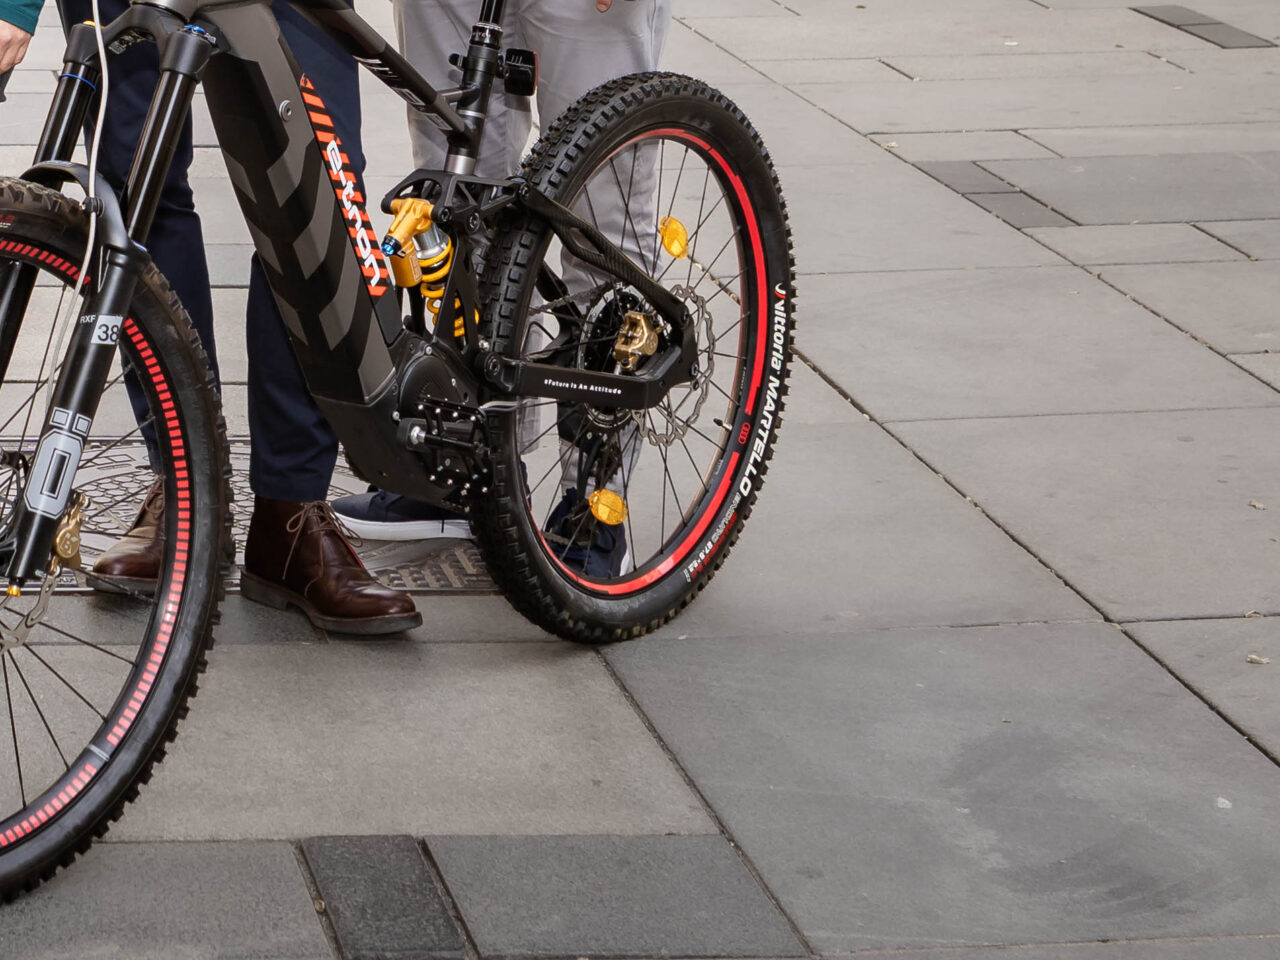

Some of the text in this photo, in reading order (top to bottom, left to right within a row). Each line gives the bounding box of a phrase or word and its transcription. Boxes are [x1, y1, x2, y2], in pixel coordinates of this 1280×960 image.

[326, 139, 380, 287] e-tron
[80, 315, 97, 324] RXF
[97, 323, 120, 342] 38
[543, 378, 570, 389] #Future
[579, 383, 588, 391] An
[589, 384, 622, 395] Attitude
[739, 374, 782, 497] MARTELLO
